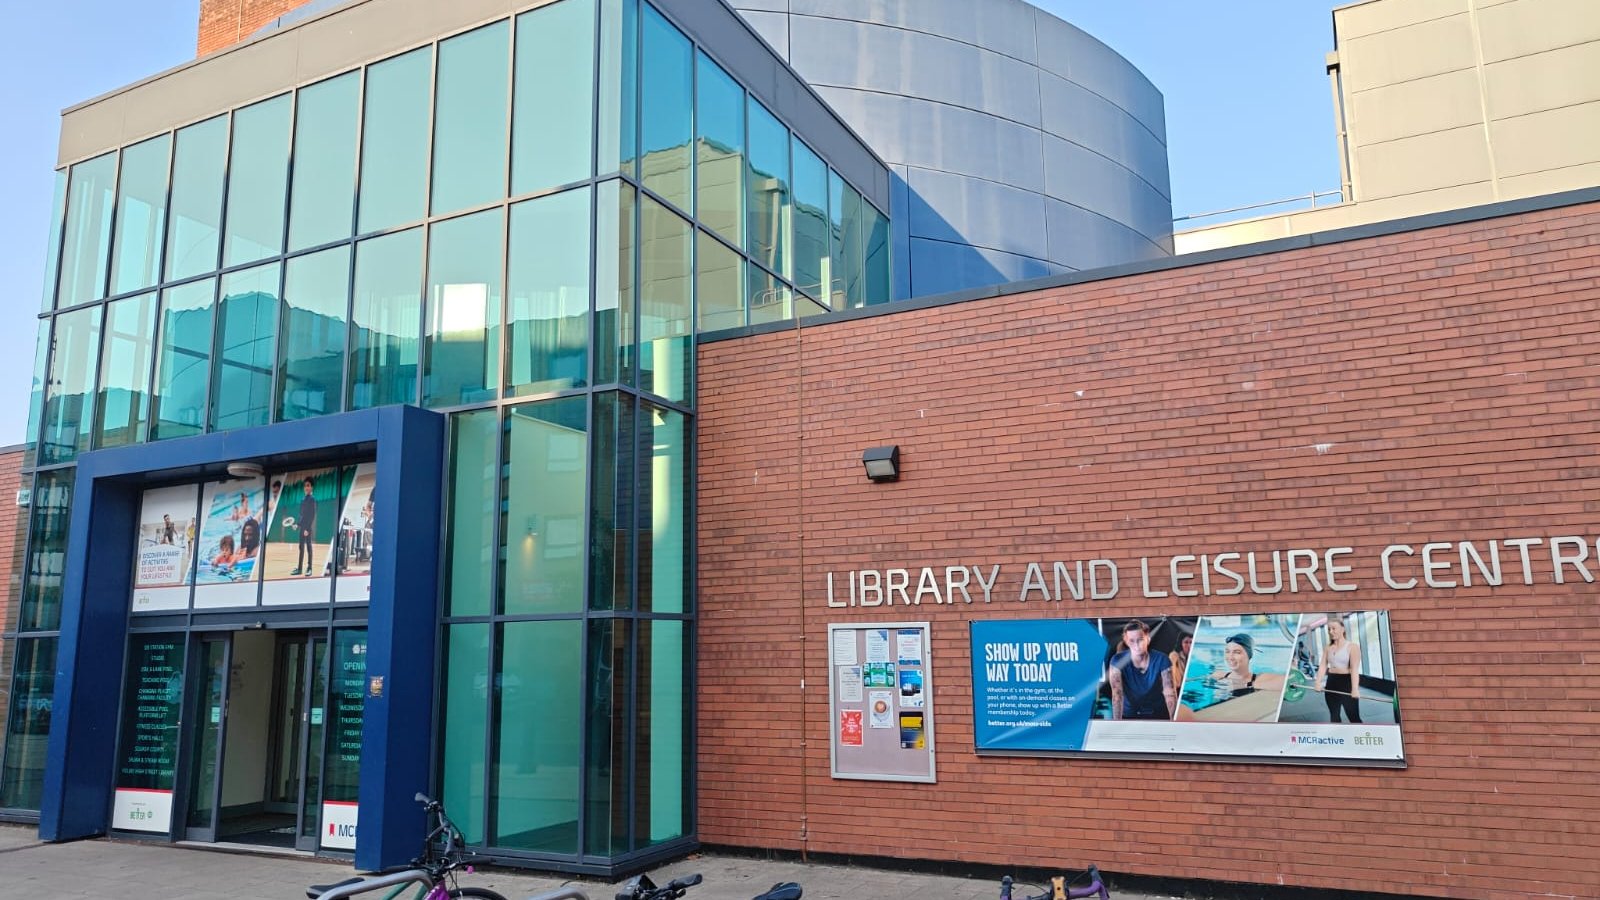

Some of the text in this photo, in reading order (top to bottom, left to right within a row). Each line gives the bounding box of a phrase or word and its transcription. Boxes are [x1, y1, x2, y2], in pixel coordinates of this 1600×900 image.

[827, 535, 1600, 608] LIBRARY AND LEISURE CENTR
[985, 642, 1078, 662] SHOW UP YOUR
[344, 662, 366, 671] OPENIN
[986, 663, 1052, 682] WAY TODAY
[1298, 734, 1384, 746] MCRactive BETTER
[339, 824, 356, 837] MC
